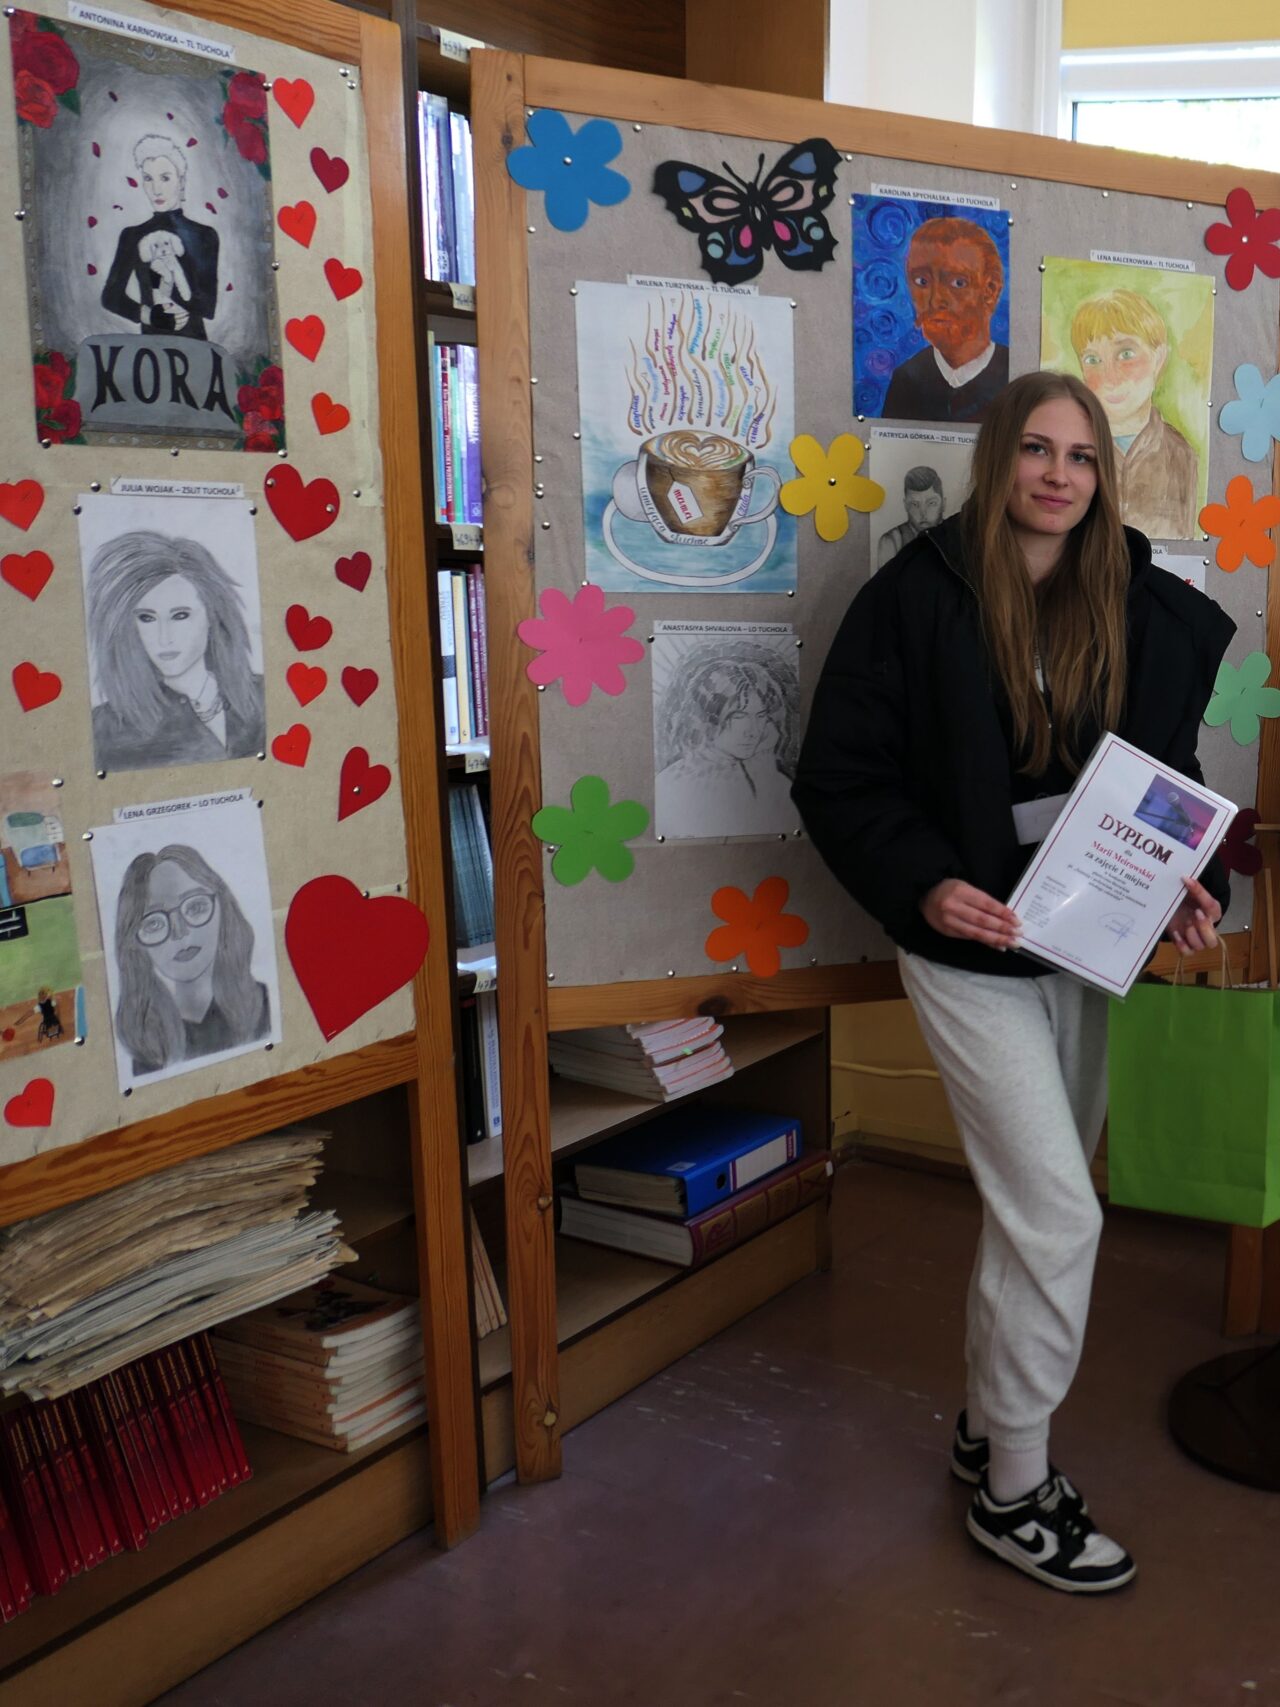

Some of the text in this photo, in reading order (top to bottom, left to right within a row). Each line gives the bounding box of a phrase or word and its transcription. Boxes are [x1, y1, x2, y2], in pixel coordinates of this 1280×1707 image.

[79, 10, 125, 30] ANTONINA
[126, 23, 178, 45] KARNOWSKA
[186, 39, 195, 49] TL
[195, 41, 230, 59] TUCHOLA
[879, 188, 911, 197] KAROLINA
[912, 191, 950, 202] SPYCHALSKA
[965, 197, 993, 207] TUCHOLA
[1113, 256, 1153, 266] BALCEROWSKA
[1165, 261, 1190, 270] TUCHOLA
[635, 279, 664, 288] MILENA
[664, 281, 705, 291] TURZYŃSKA
[720, 286, 751, 295] TUCHOLA
[87, 343, 236, 421] KORA
[878, 431, 909, 439] PATRYCJA
[909, 431, 935, 441] GÓRSKA
[121, 484, 143, 493] JULIA
[144, 485, 174, 494] WOJAK
[202, 487, 236, 496] TUCHOLA
[673, 488, 693, 521] mama
[662, 624, 703, 632] ANASTASIYA
[123, 809, 143, 819] LENA
[146, 802, 191, 816] GRZEGOREK
[199, 799, 209, 808] LO
[210, 794, 243, 805] TUCHOLA
[1091, 840, 1114, 858] Marii
[1097, 813, 1174, 866] DYPLOM
[1084, 851, 1094, 859] za
[1094, 856, 1119, 873] zajęcie
[1124, 872, 1150, 890] miejsca
